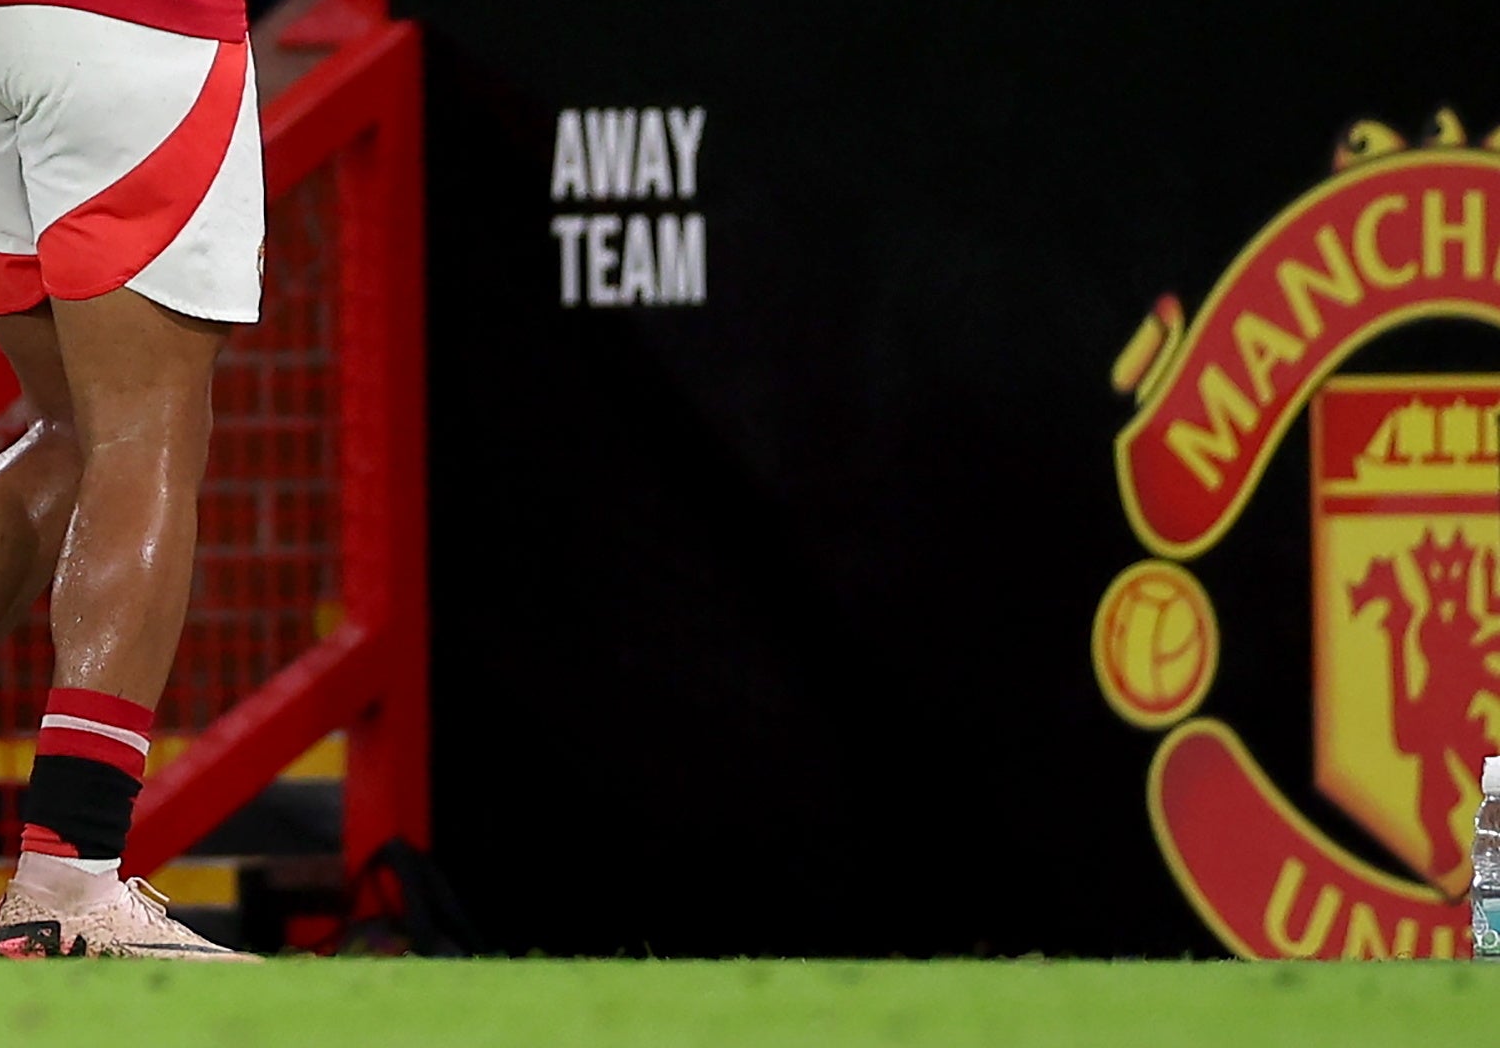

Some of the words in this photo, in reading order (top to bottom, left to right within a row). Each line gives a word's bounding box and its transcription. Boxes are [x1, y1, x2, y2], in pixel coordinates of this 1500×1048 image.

[551, 107, 706, 200] AWAY
[551, 213, 706, 307] TEAM
[1164, 189, 1500, 490] MANCH
